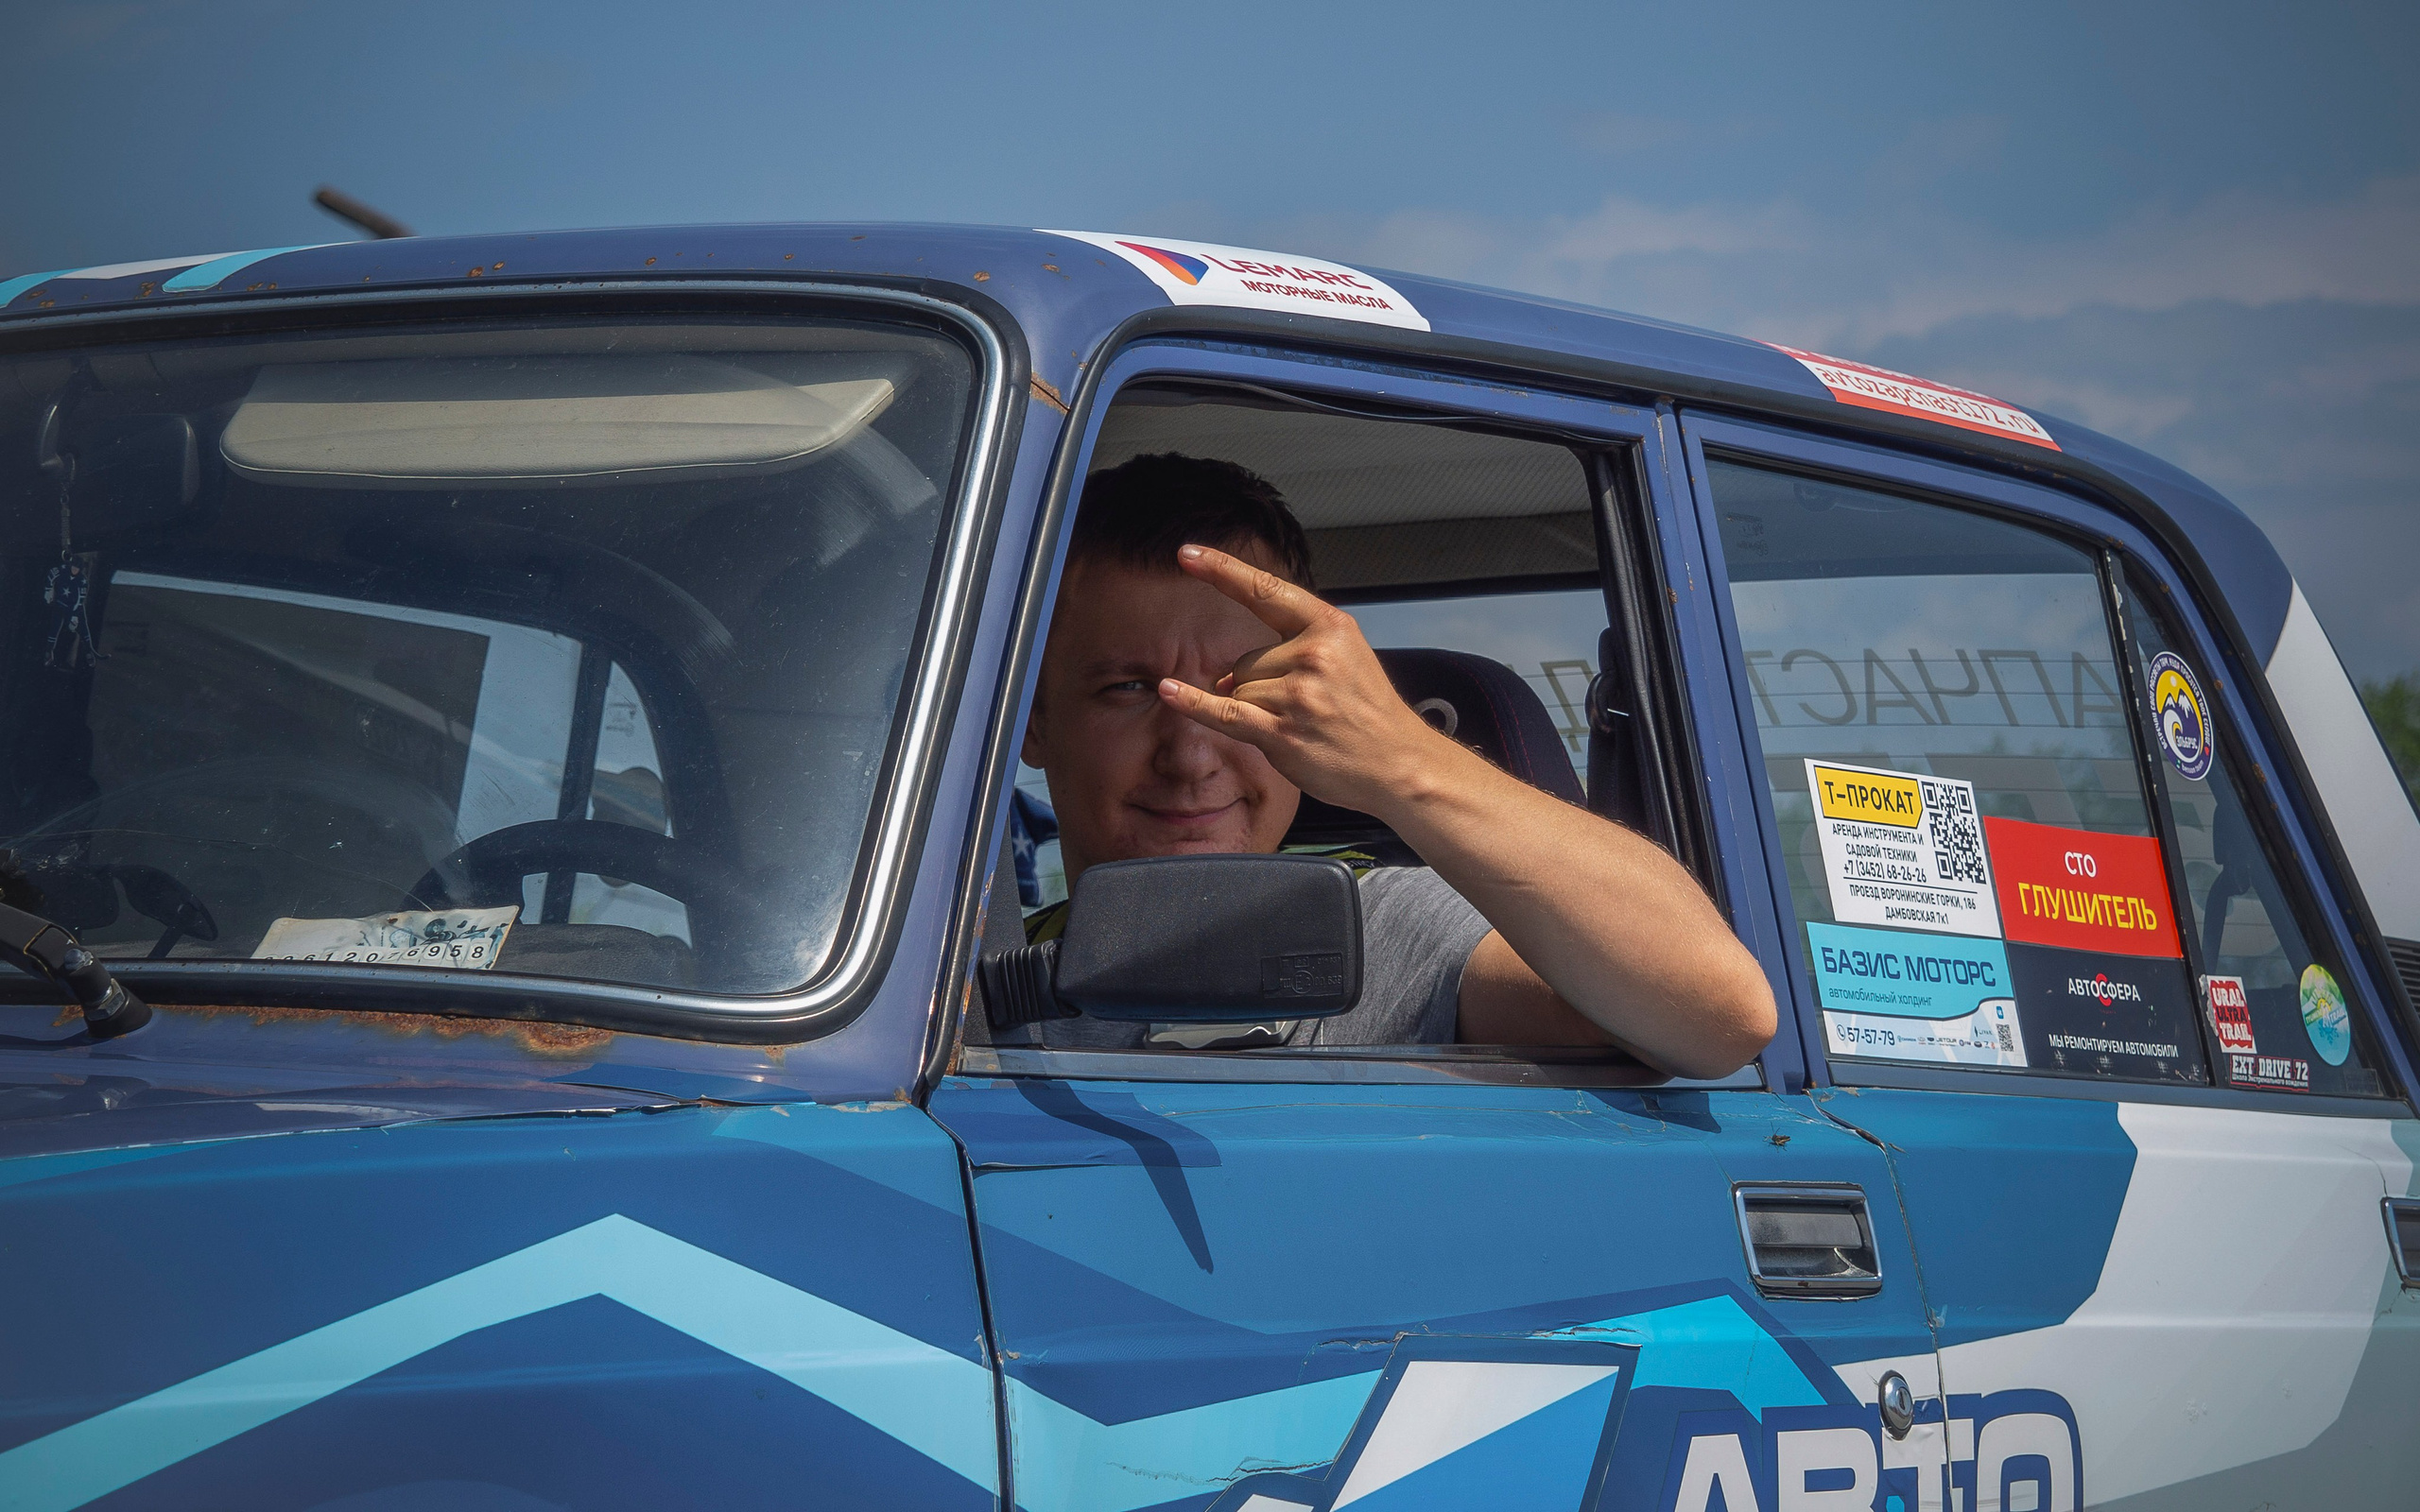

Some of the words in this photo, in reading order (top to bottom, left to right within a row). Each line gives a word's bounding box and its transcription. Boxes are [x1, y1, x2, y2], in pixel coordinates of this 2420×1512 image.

[1201, 253, 1374, 290] LEMARC
[1241, 279, 1334, 302] МОТОРНЫЕ
[1336, 291, 1393, 311] МАСЛА
[1815, 367, 2040, 434] avtozapchasti72.ru
[1824, 781, 1913, 815] Т-ПРОКАТ
[1833, 823, 1862, 839] АРЕНДА
[1863, 827, 1917, 844] ИНСТРУМЕНТА
[1918, 833, 1924, 845] И
[1846, 843, 1881, 858] САДОВОЙ
[1882, 847, 1917, 862] ТЕХНИКИ
[2065, 851, 2098, 878] СТО
[1844, 860, 1853, 875] +7
[1856, 860, 1885, 879] (3452)
[1887, 864, 1927, 883] 68-26-26
[1850, 885, 1880, 901] ПРОЕЗД
[1881, 887, 1935, 905] ВОРОНИНСКИЕ
[1936, 894, 1962, 910] ГОРКИ,
[1963, 898, 1977, 909] 186
[2018, 883, 2157, 931] ГЛУШИТЕЛЬ
[1885, 906, 1936, 923] ДАМБОВСКАЯ
[1822, 947, 1900, 979] БАЗИС
[1905, 955, 1996, 987] МОТОРС
[1829, 988, 1896, 1004] автомобильный
[1899, 994, 1932, 1008] холдинг
[2068, 975, 2141, 1004] АВТОСФЕРА
[2211, 988, 2245, 1007] URAL
[2216, 1005, 2247, 1022] ULTRA
[1847, 1027, 1895, 1046] 57-57-79
[2220, 1022, 2251, 1040] TRAIL
[2048, 1034, 2065, 1047] МЫ
[2066, 1037, 2125, 1054] РЕМОНТИРУЕМ
[2125, 1040, 2179, 1057] АВТОМОБИЛИ
[2232, 1055, 2255, 1074] EXT
[2258, 1058, 2290, 1078] DRIVE
[2295, 1061, 2308, 1080] 72
